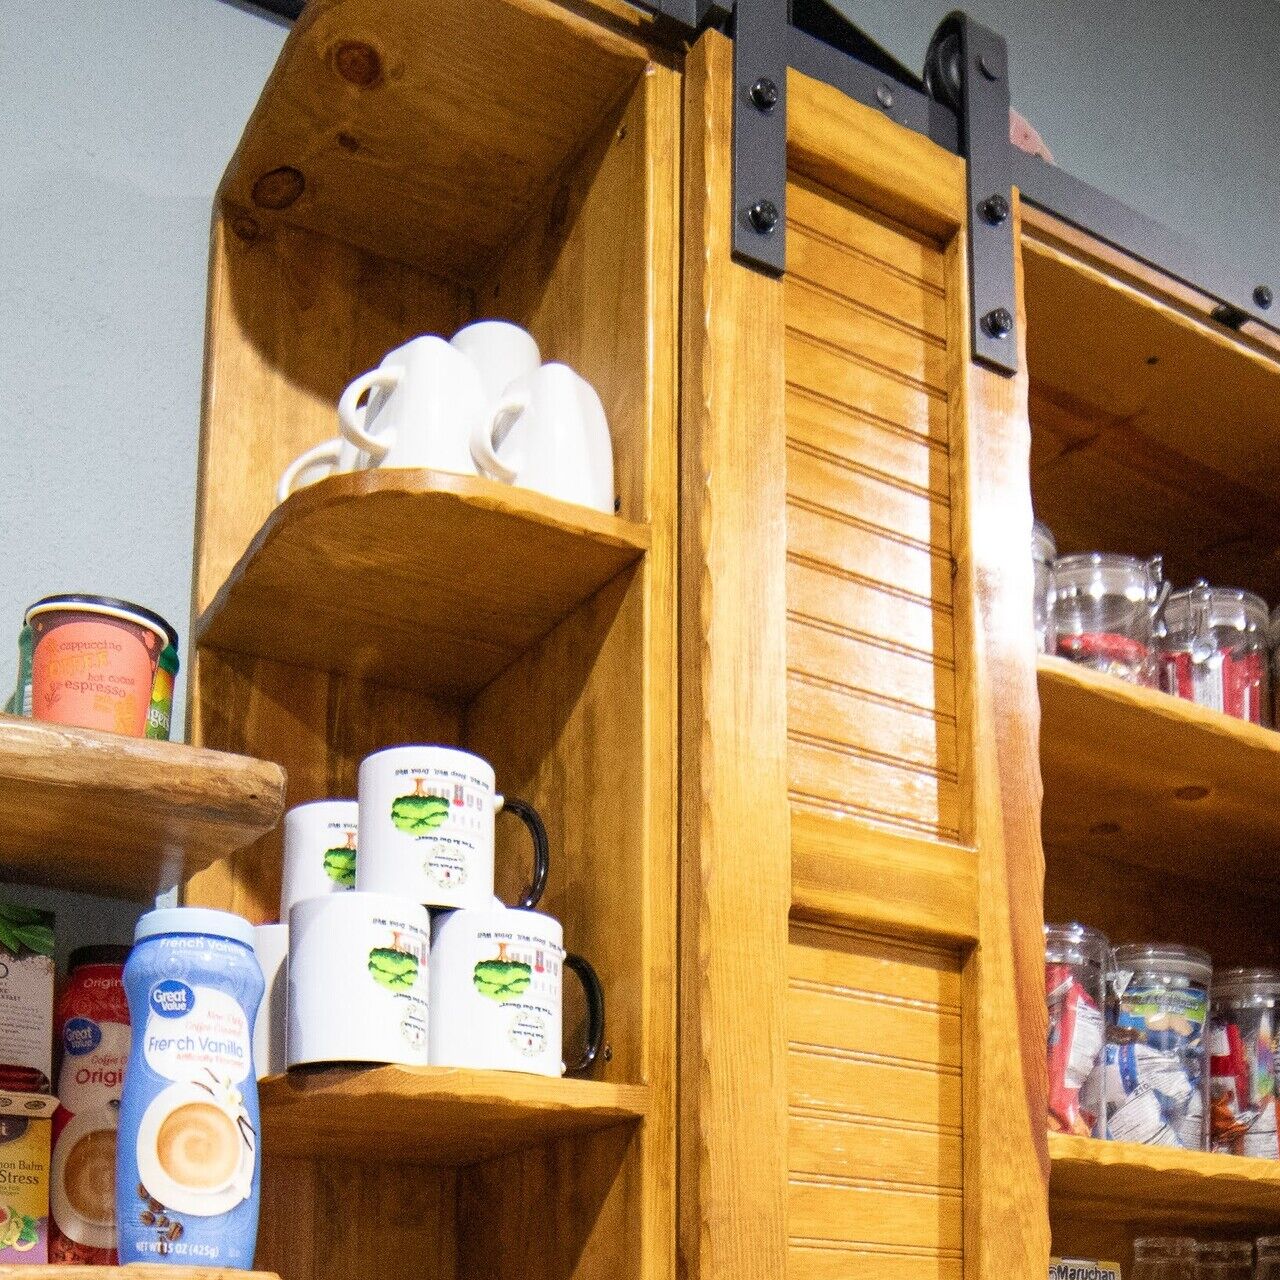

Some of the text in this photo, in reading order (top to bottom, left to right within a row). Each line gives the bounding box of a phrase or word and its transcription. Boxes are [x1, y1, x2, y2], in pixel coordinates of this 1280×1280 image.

[59, 639, 123, 652] cappuccino
[64, 681, 126, 698] espresso
[83, 977, 123, 989] Origin
[152, 989, 187, 1004] Great
[148, 1036, 244, 1059] French Vanilla
[75, 1069, 123, 1088] Origi
[18, 1159, 44, 1172] Balm
[175, 1243, 188, 1254] OZ
